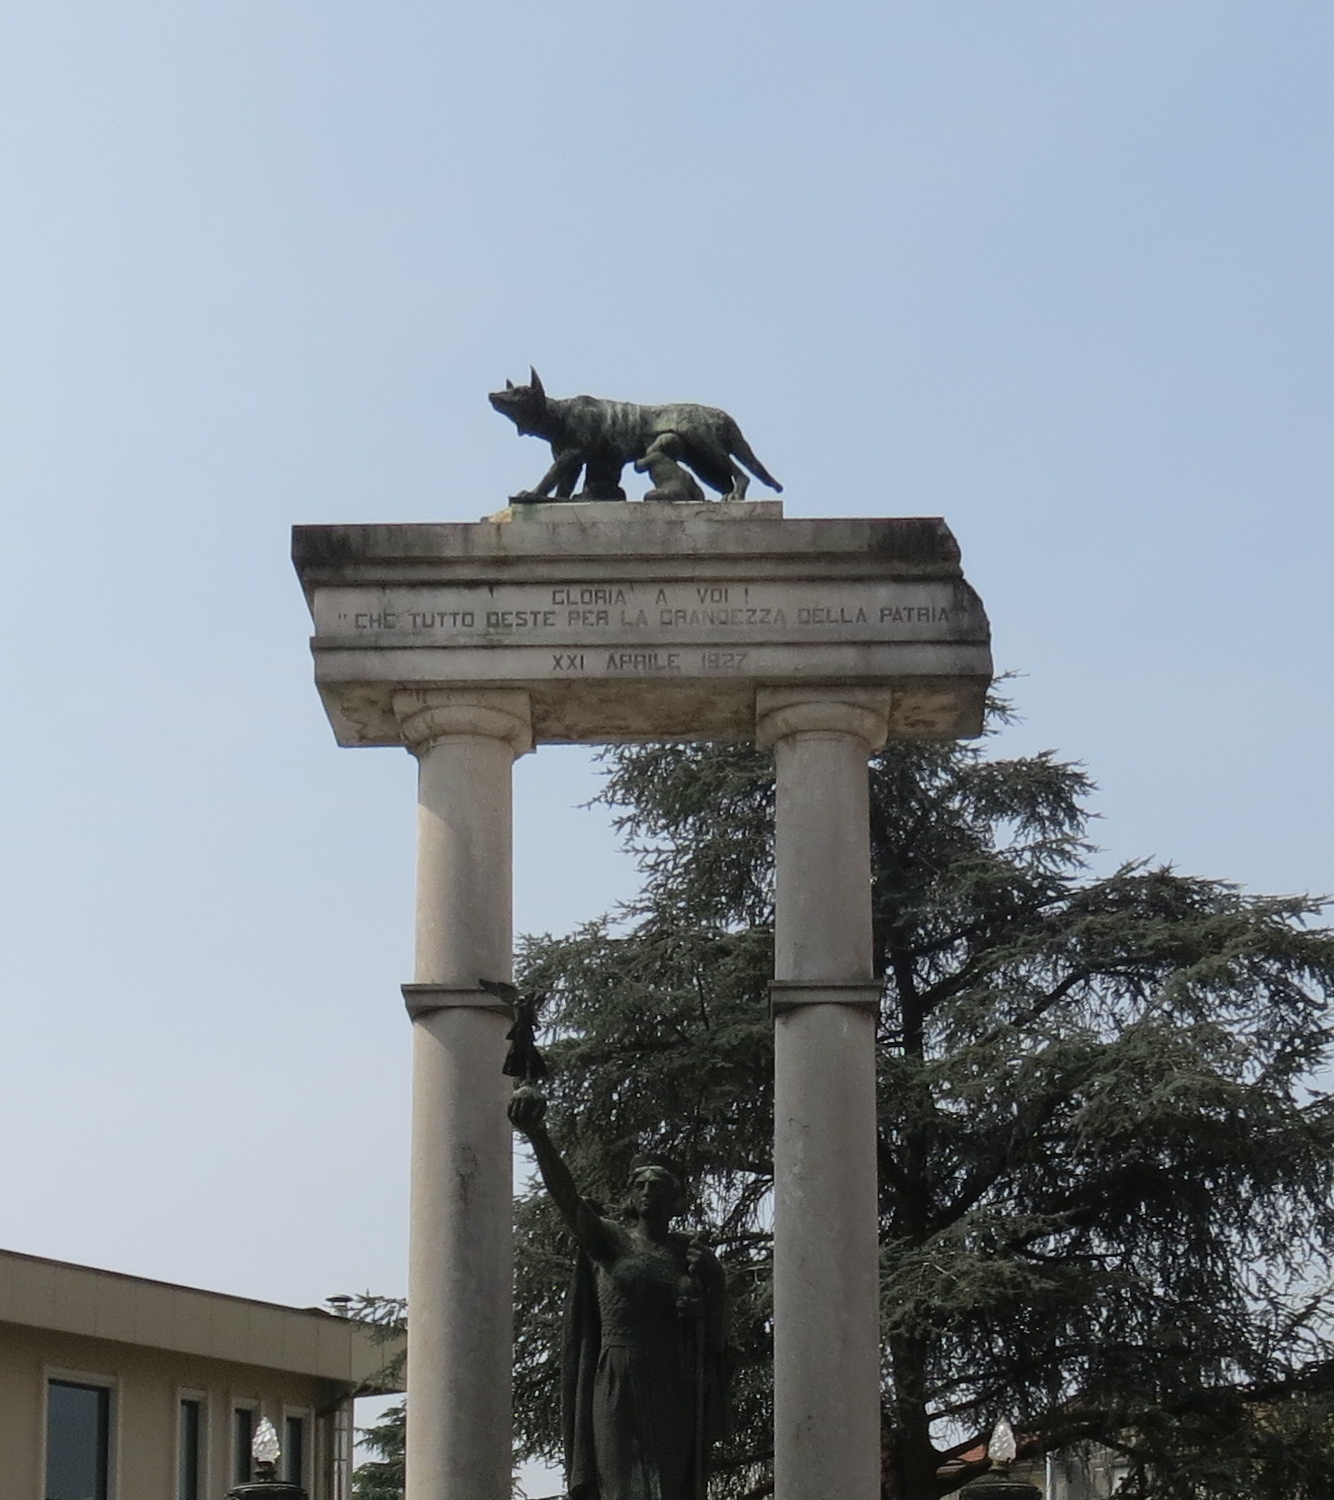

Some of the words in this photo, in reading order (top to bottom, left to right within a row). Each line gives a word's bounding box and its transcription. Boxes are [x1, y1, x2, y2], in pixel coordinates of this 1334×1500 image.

[552, 588, 627, 606] GLORIA
[697, 588, 729, 604] VOI
[354, 612, 397, 630] CHE
[408, 611, 475, 629] TUTTO
[568, 609, 610, 627] PER
[620, 609, 649, 627] LA
[659, 607, 786, 626] GRANDEZZA
[797, 607, 867, 625] DELLA
[879, 606, 950, 624] PATRIA
[552, 653, 585, 671] XXI
[606, 652, 681, 671] APRILE
